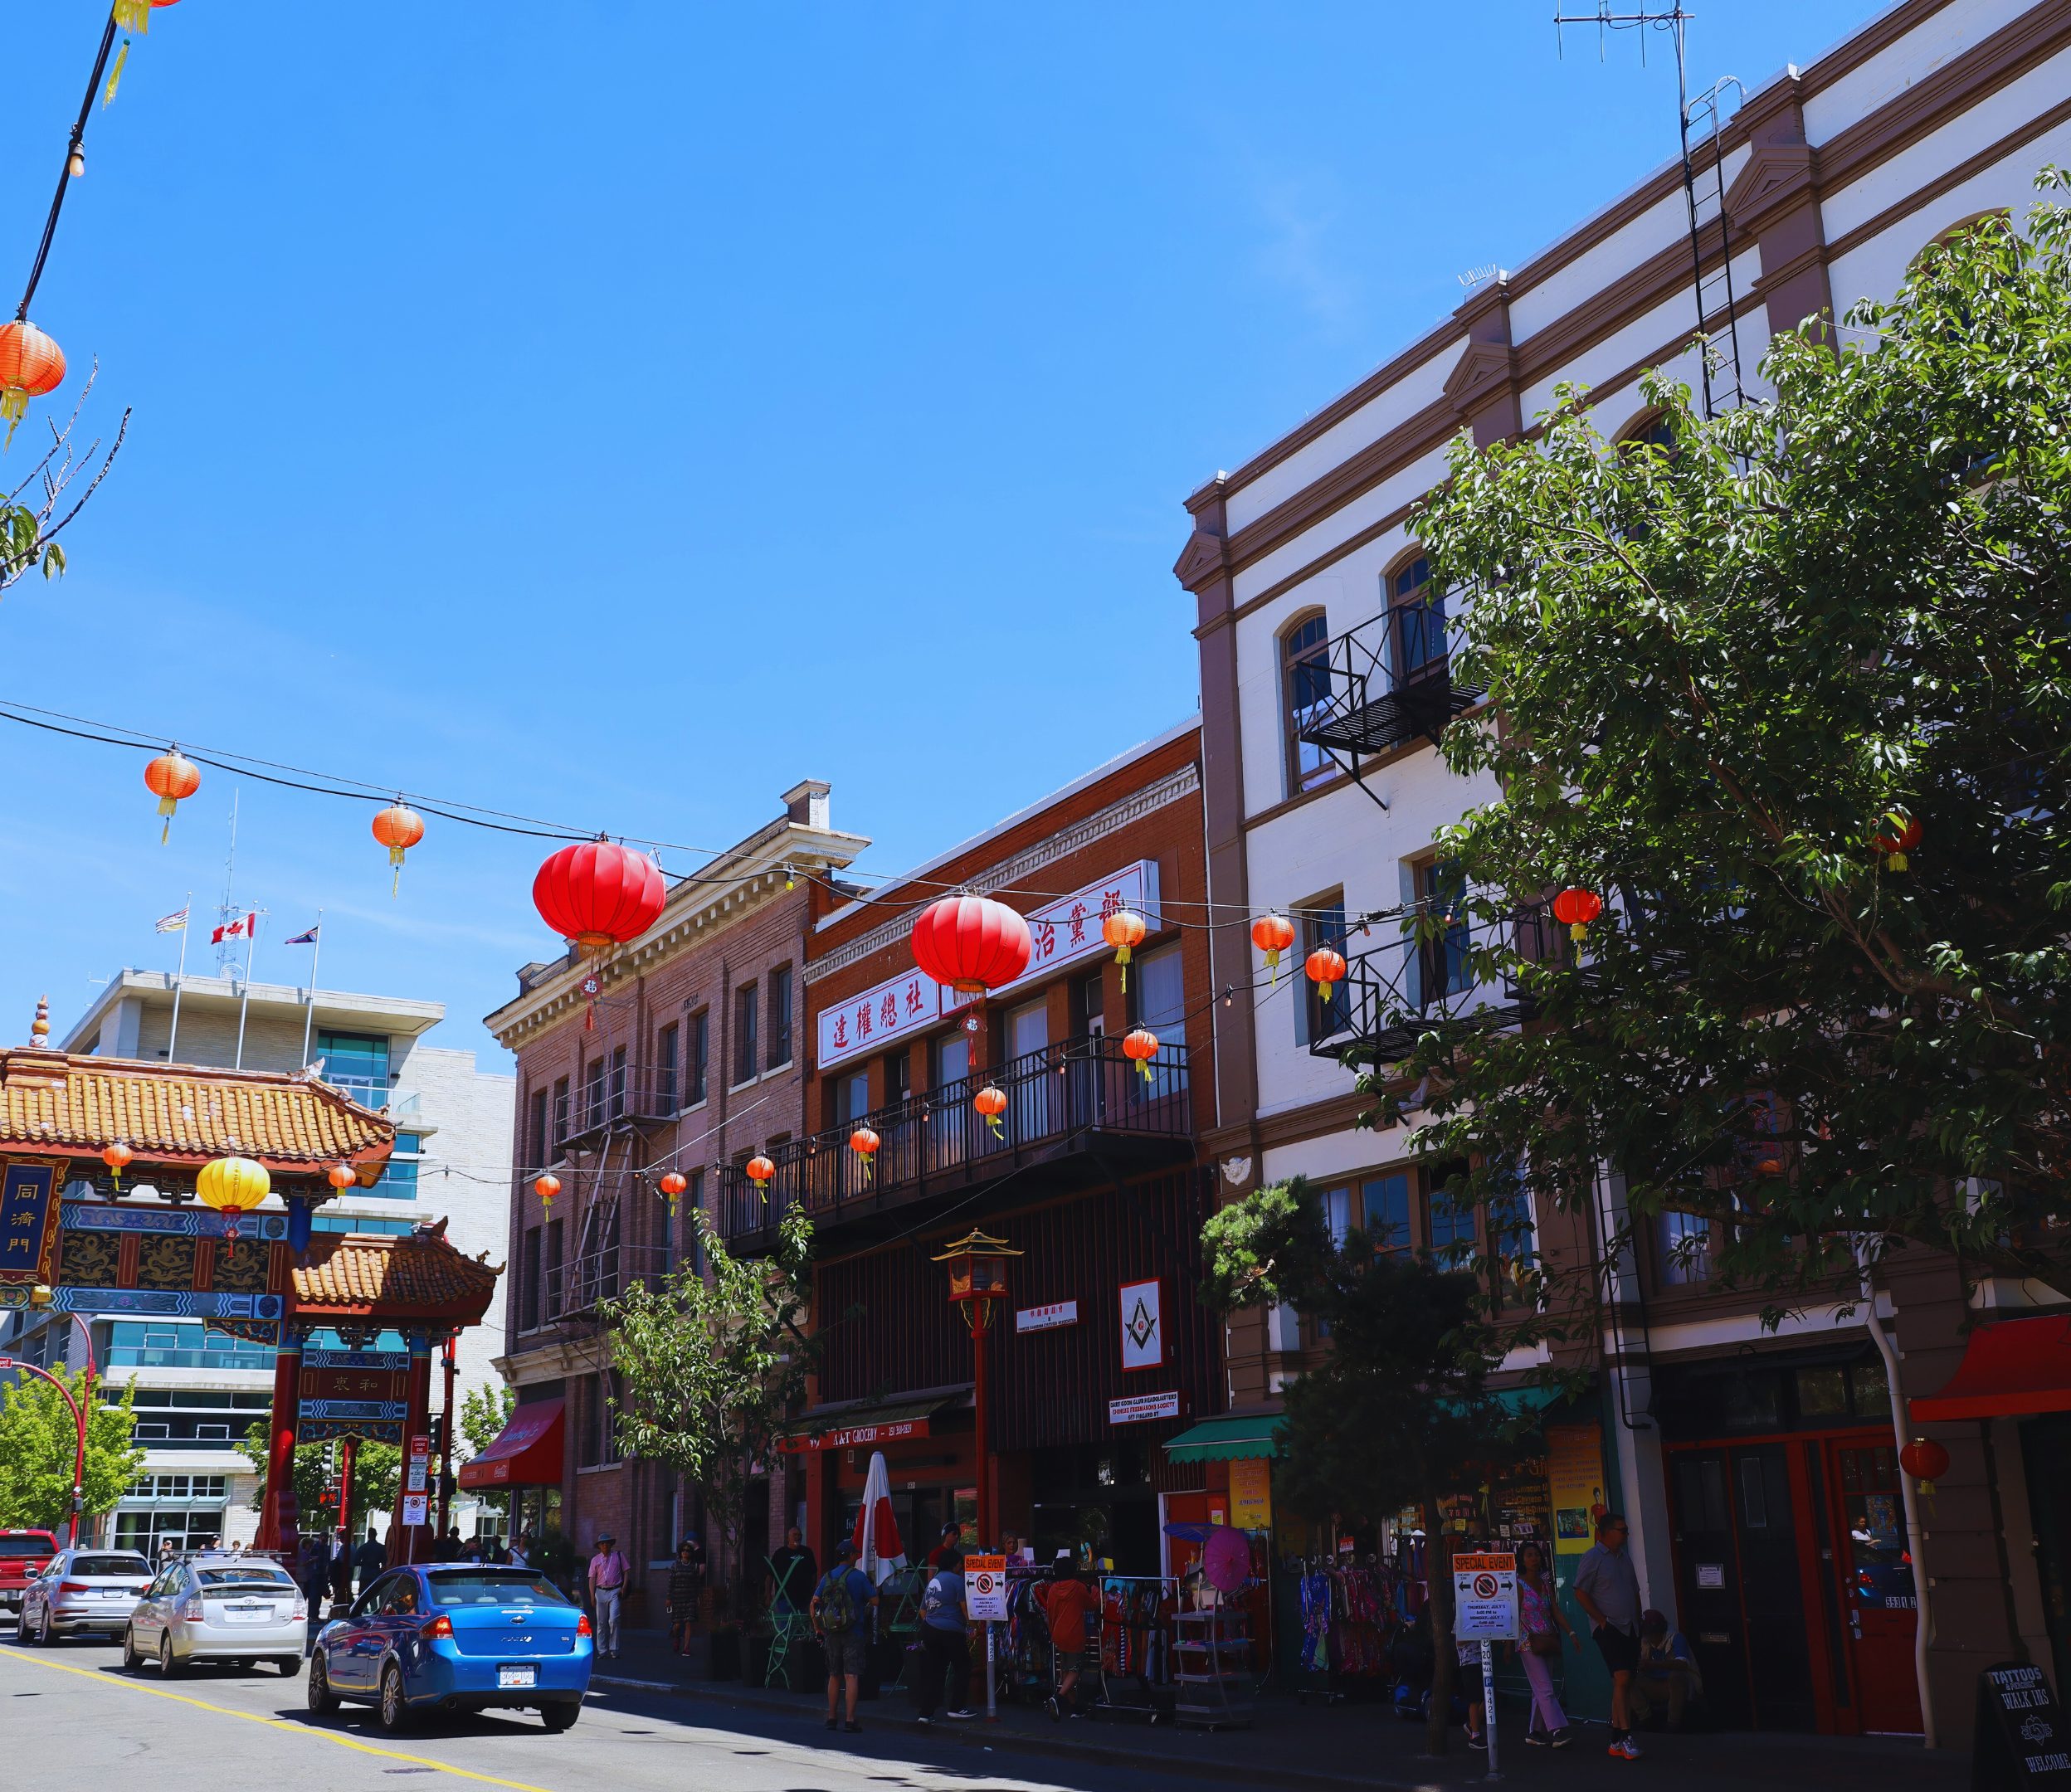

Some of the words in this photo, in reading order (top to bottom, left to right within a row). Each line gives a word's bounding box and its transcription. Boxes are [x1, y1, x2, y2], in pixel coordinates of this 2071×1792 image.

[833, 979, 923, 1048] 達權總社
[7, 1184, 39, 1253] 同濟門
[853, 1427, 878, 1444] GROCERY
[966, 1558, 987, 1568] SPECIAL
[988, 1559, 1004, 1568] EVENT
[1455, 1556, 1487, 1570] SPECIAL
[1489, 1556, 1513, 1569] EVENT
[1482, 1650, 1491, 1659] 20
[1991, 1667, 2043, 1684] TATTOOS
[2001, 1691, 2032, 1710] WALK
[2030, 1688, 2049, 1706] INS
[2025, 1753, 2071, 1773] WELCOME
